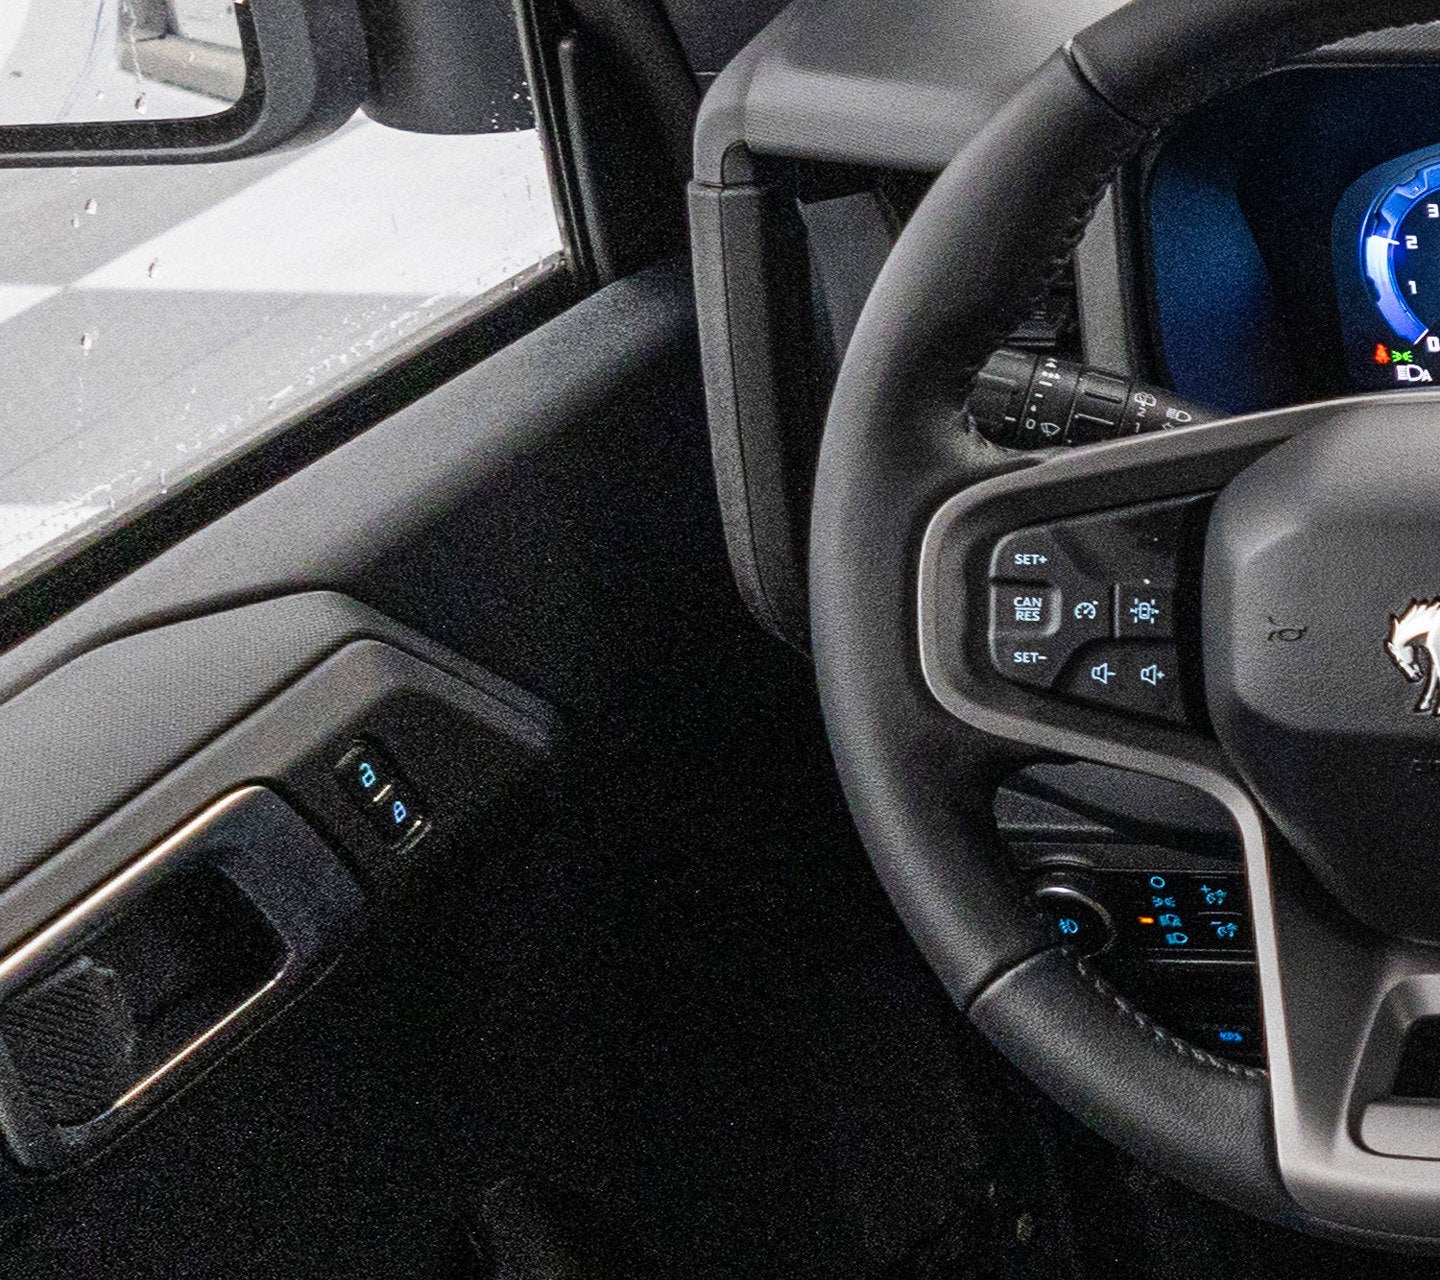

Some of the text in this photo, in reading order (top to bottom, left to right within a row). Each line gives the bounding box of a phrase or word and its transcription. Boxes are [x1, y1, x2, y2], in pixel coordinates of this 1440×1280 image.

[1428, 204, 1439, 218] 3
[1406, 235, 1418, 249] 2
[1408, 280, 1417, 294] 1
[1015, 554, 1048, 565] SET+
[1014, 597, 1042, 607] CAN
[1016, 611, 1041, 621] RES
